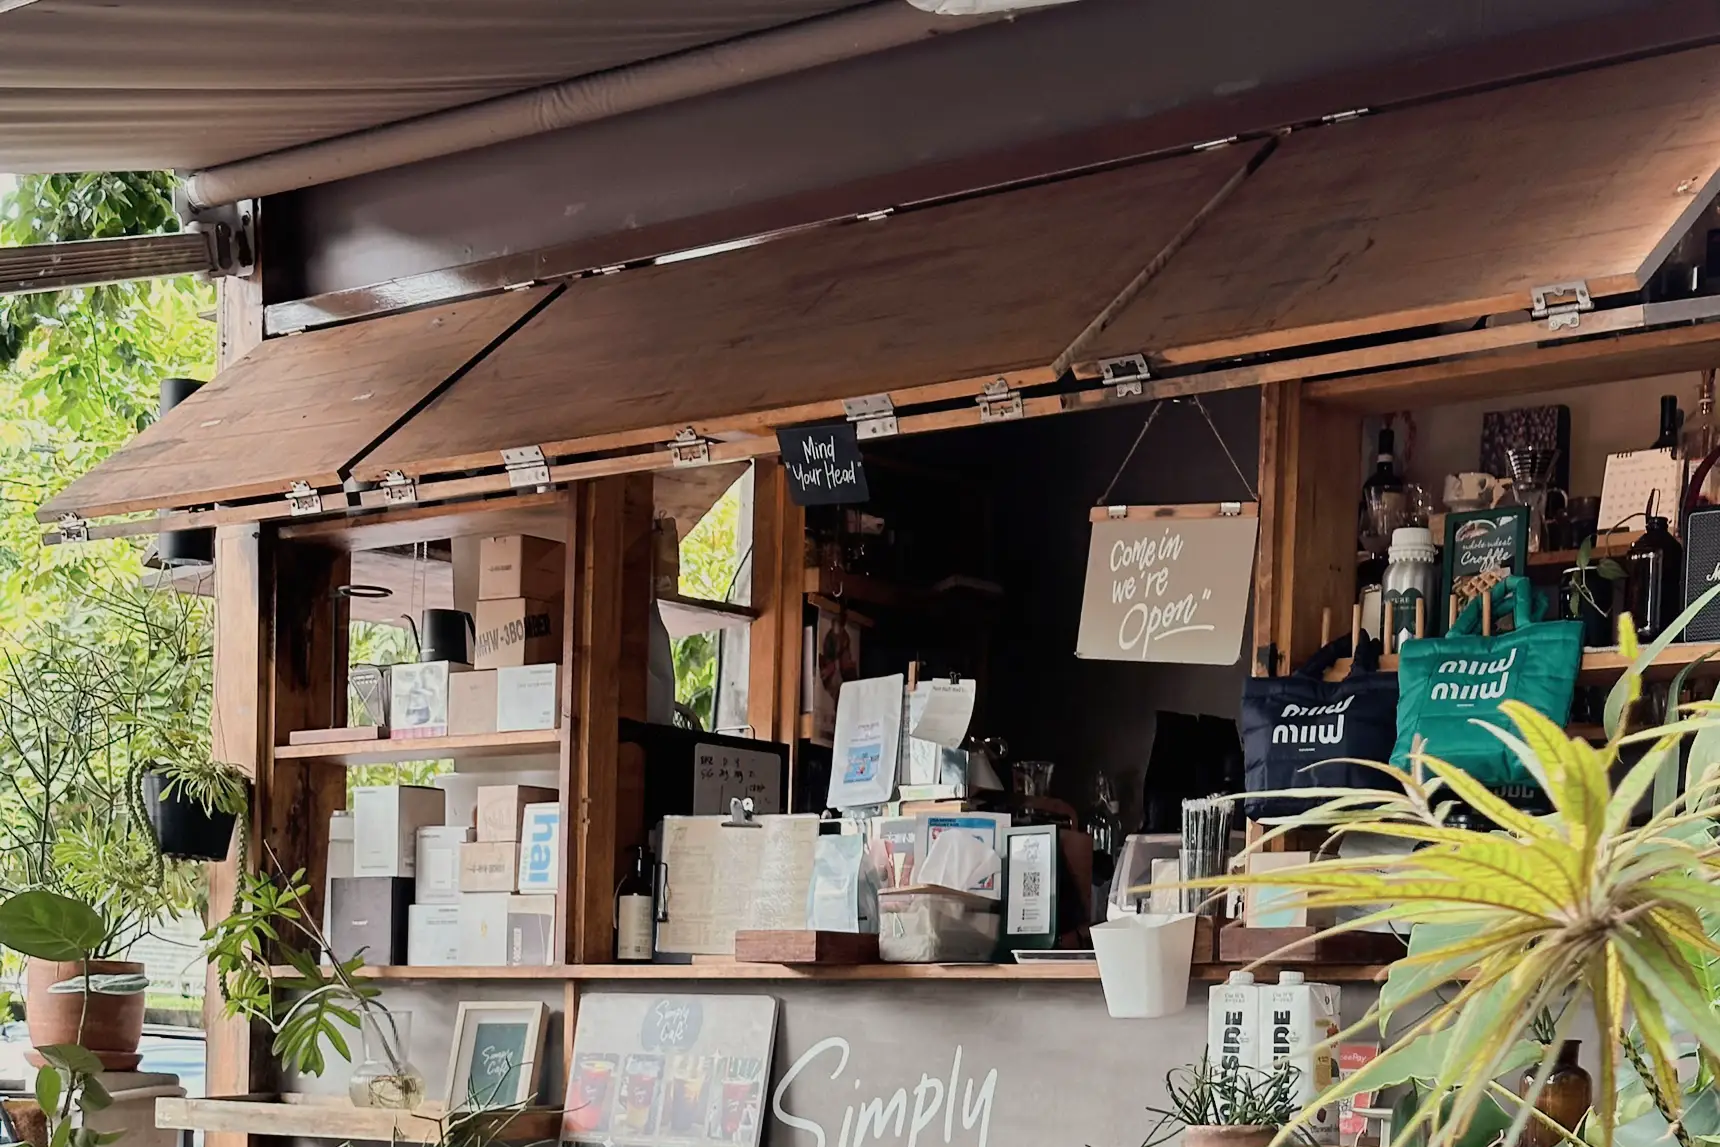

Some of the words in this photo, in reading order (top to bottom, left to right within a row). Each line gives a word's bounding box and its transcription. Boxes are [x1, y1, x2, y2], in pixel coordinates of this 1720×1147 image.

[803, 435, 836, 464] Mind
[1110, 537, 1156, 572] Come
[1158, 527, 1184, 560] in
[1460, 548, 1513, 571] Croffle
[1112, 566, 1169, 604] we're
